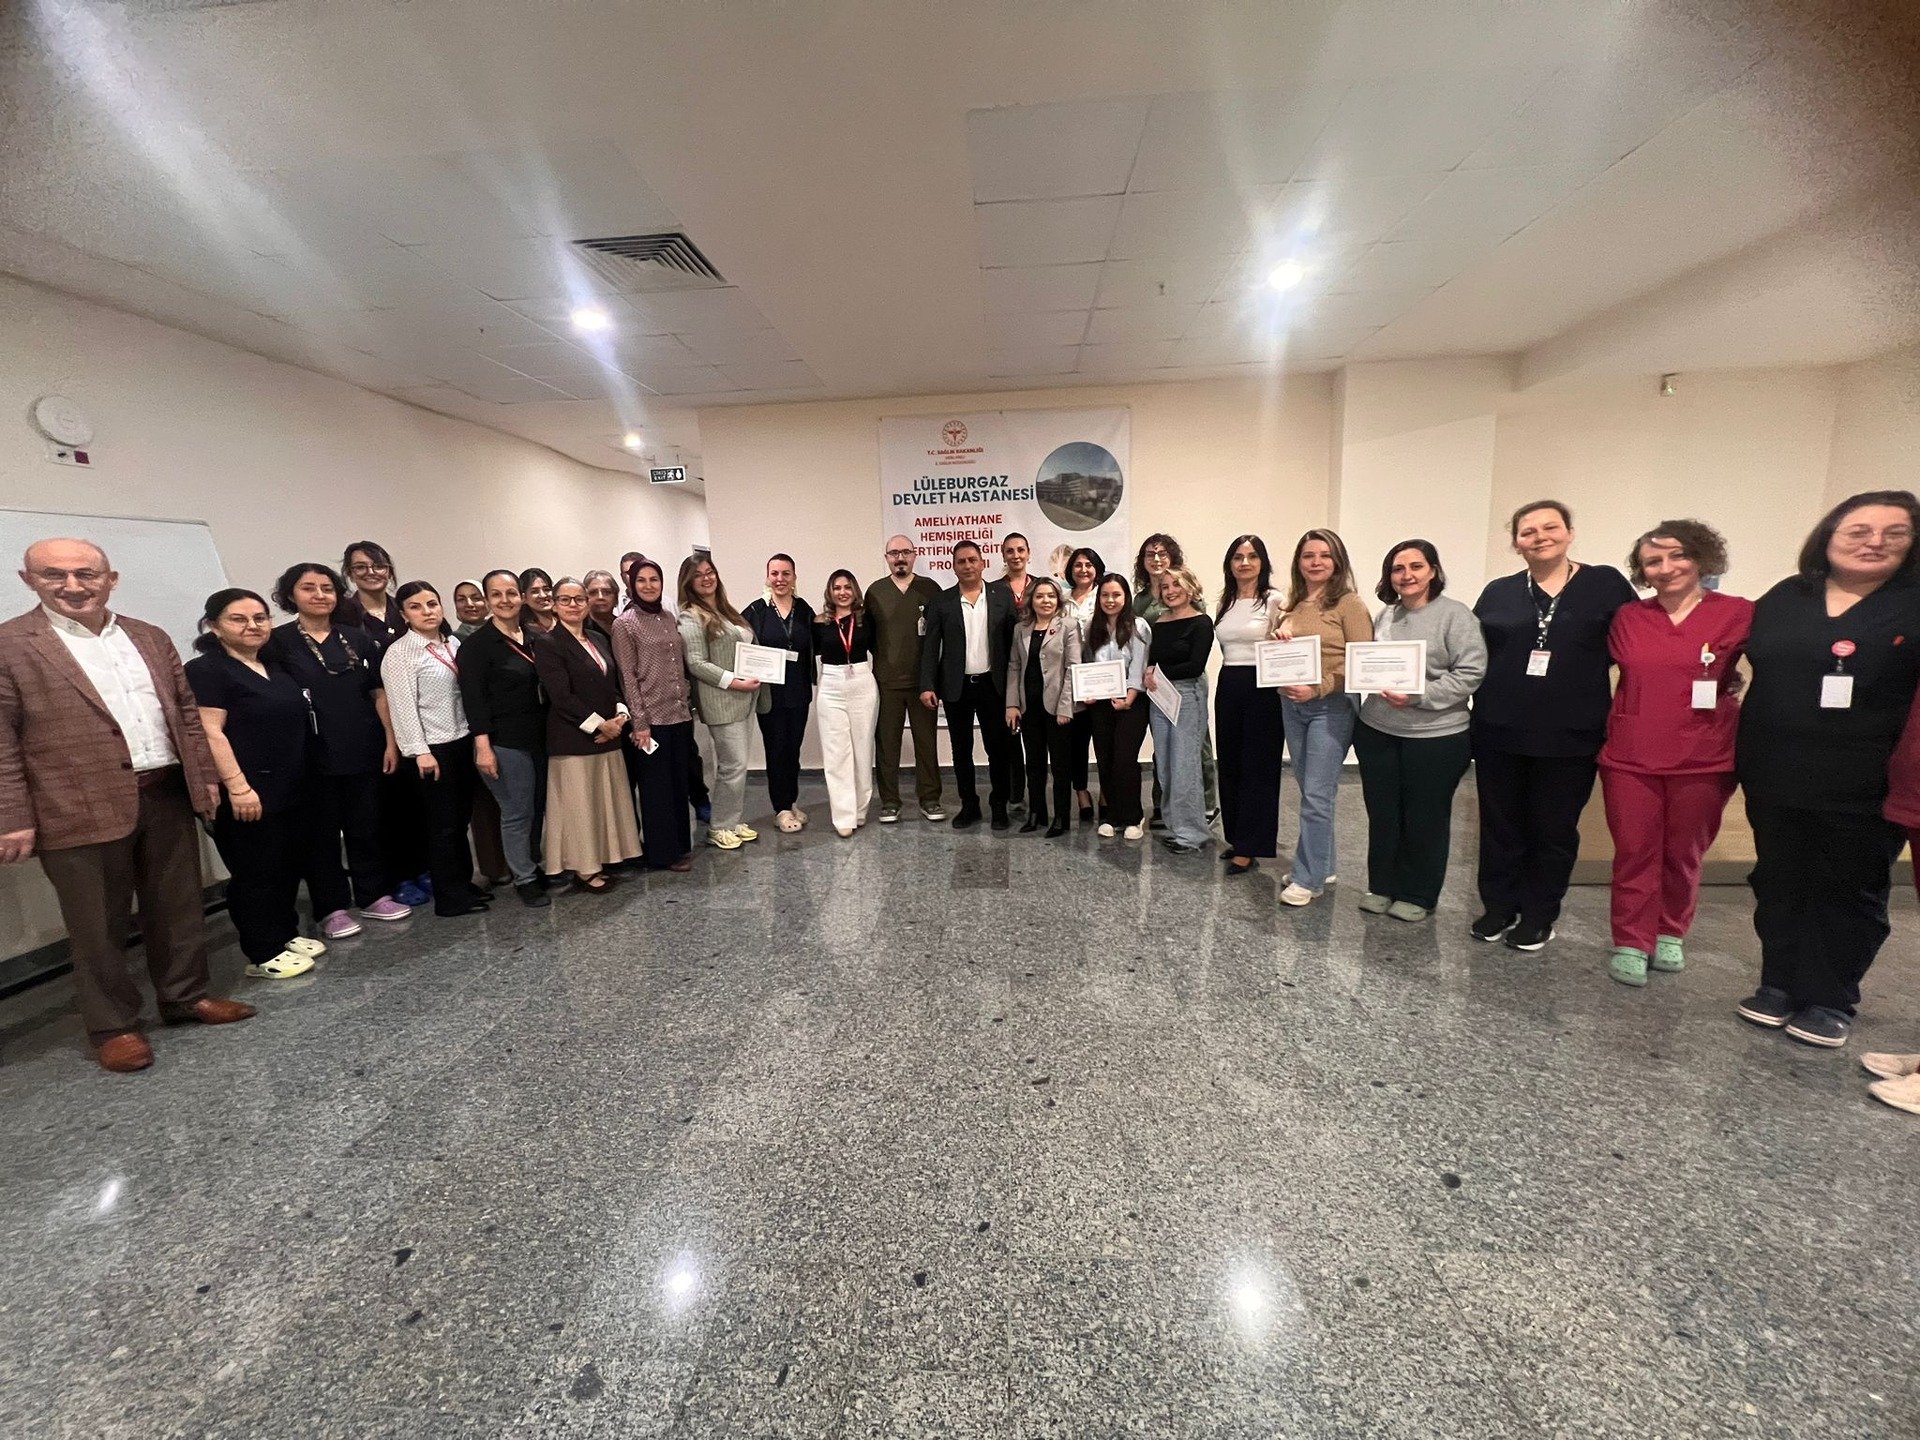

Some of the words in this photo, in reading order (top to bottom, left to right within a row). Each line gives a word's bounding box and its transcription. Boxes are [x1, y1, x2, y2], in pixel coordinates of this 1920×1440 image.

[914, 475, 1008, 491] LÜLEBURGAZ
[893, 492, 946, 506] DEVLET
[950, 485, 1034, 504] HASTANESİ
[914, 513, 1003, 527] AMELİYATHANE
[920, 527, 993, 543] HEMŞİRELİĞİ
